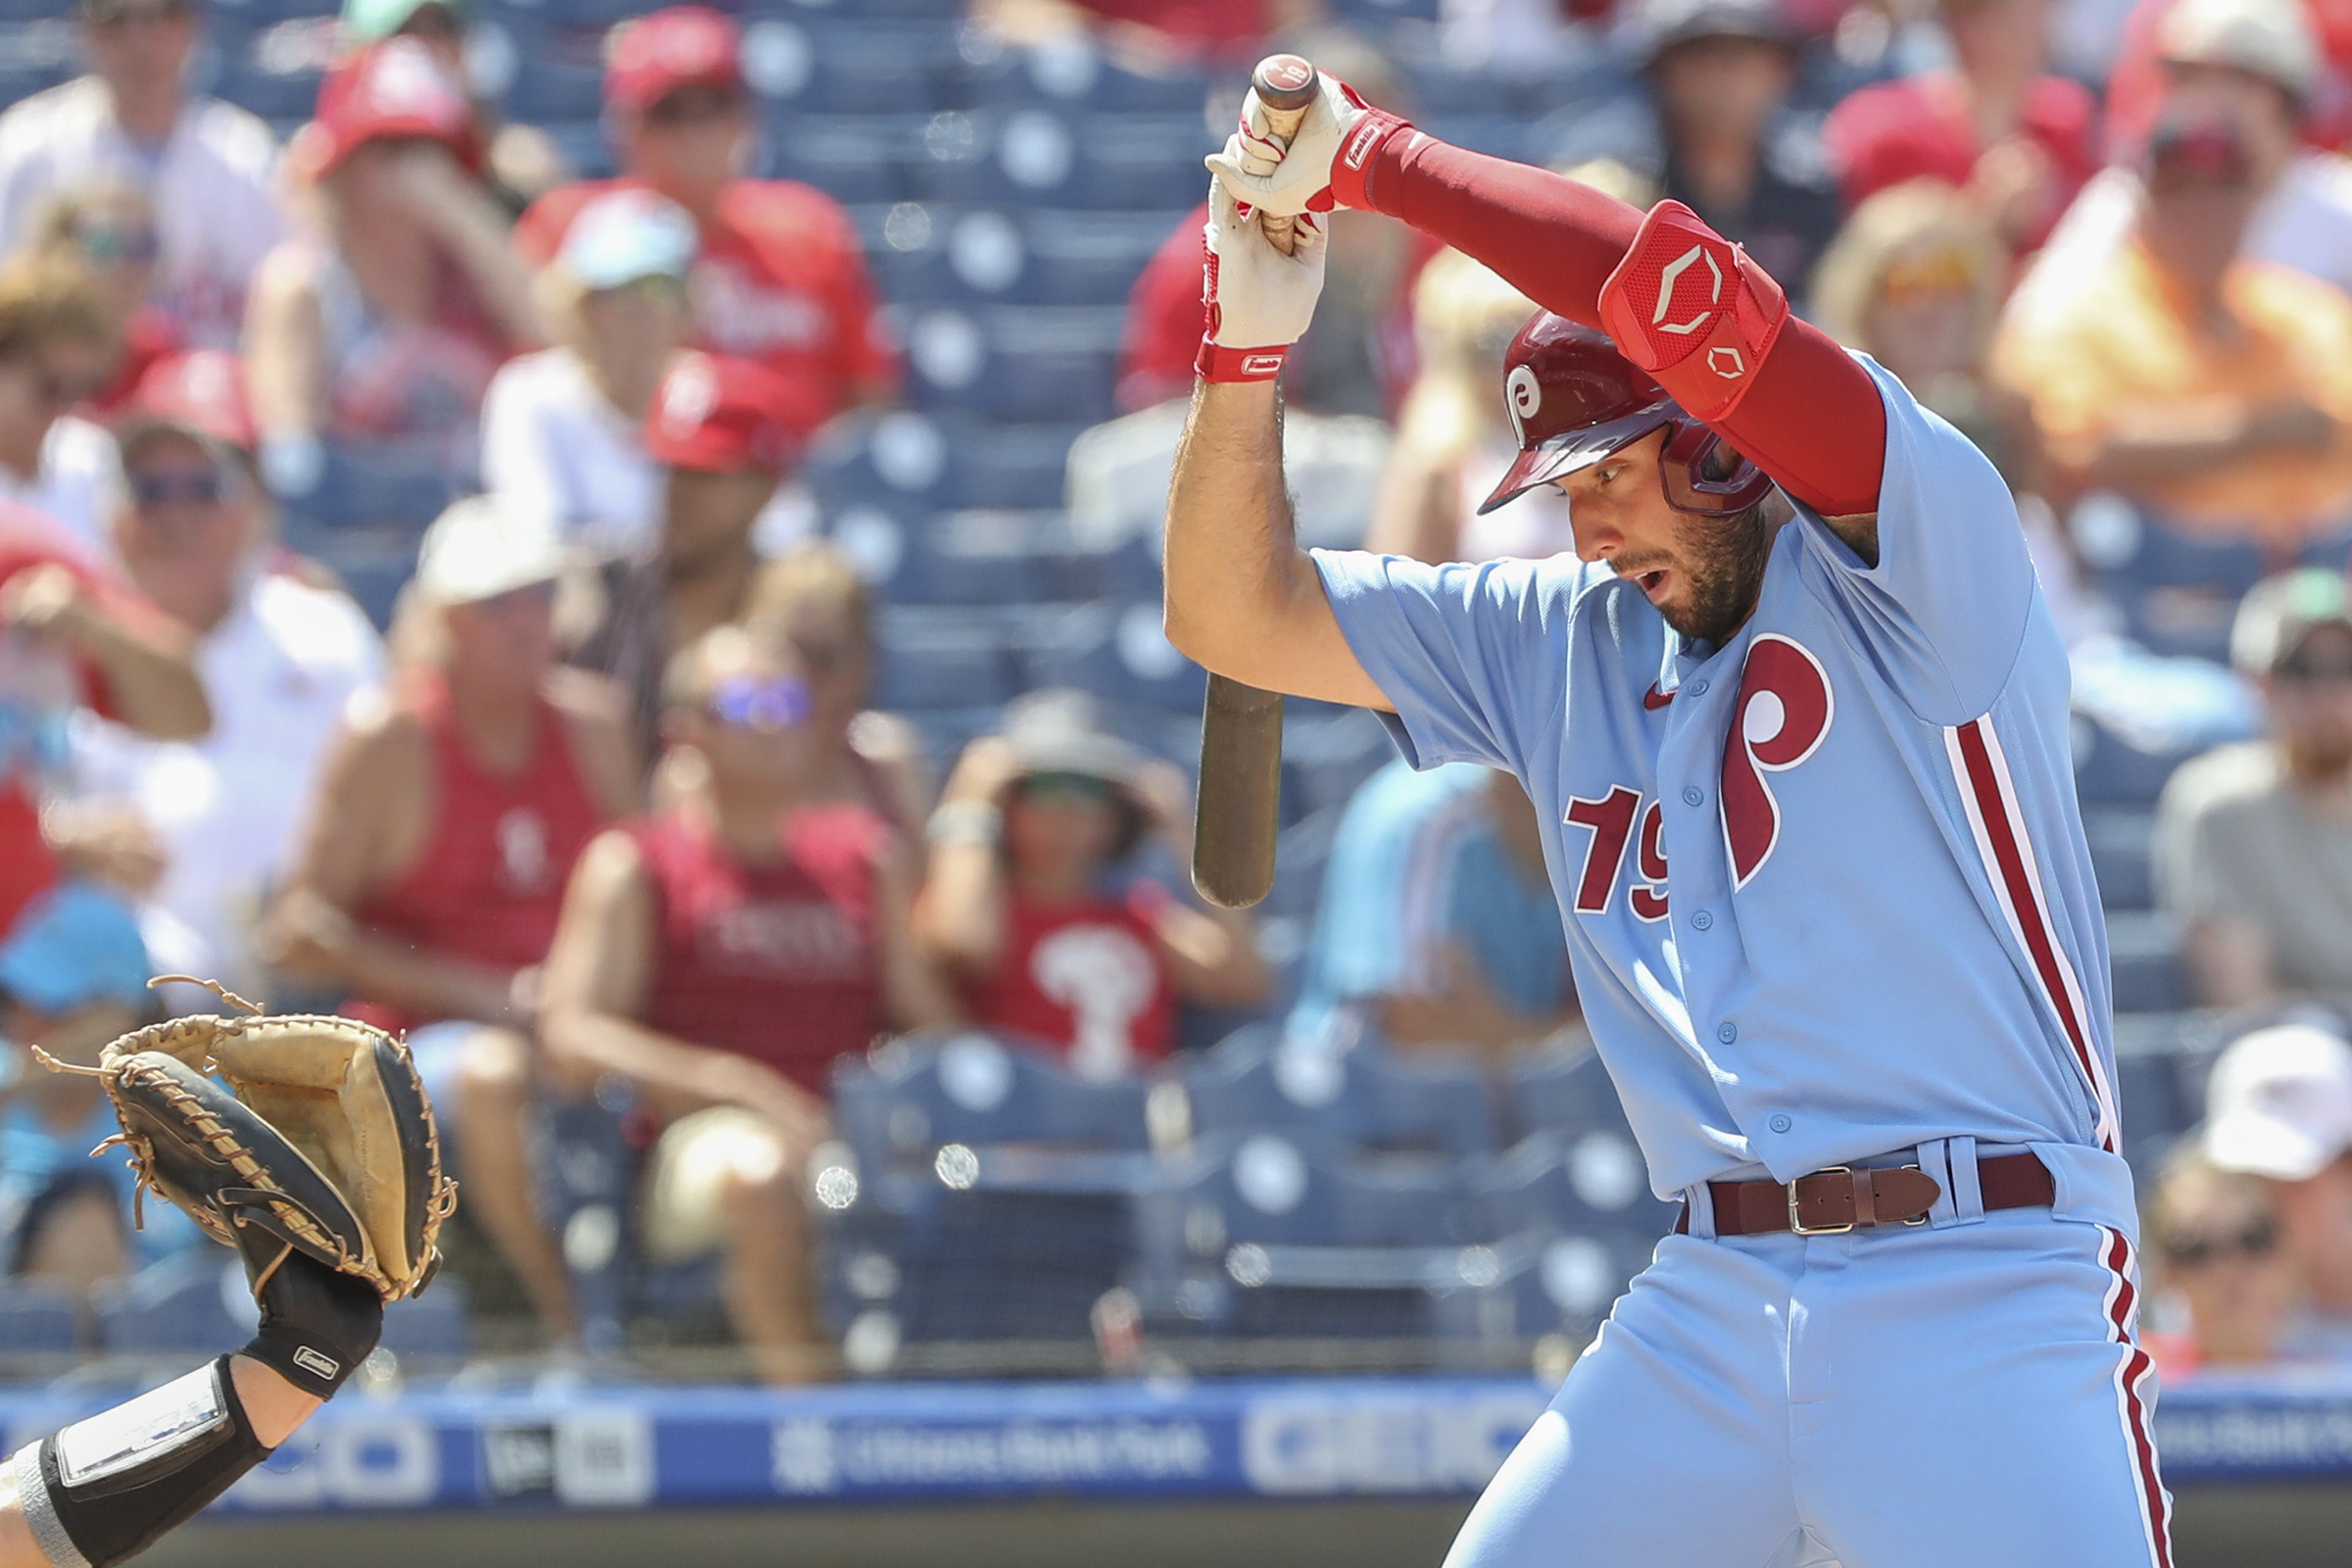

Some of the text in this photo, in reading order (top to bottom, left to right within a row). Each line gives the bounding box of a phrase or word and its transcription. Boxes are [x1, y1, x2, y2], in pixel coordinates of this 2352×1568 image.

[1281, 65, 1308, 84] 19
[1506, 365, 1542, 450] P
[1718, 632, 1835, 894] P
[1563, 783, 1670, 923] 19
[1241, 1401, 1541, 1495] GEIC
